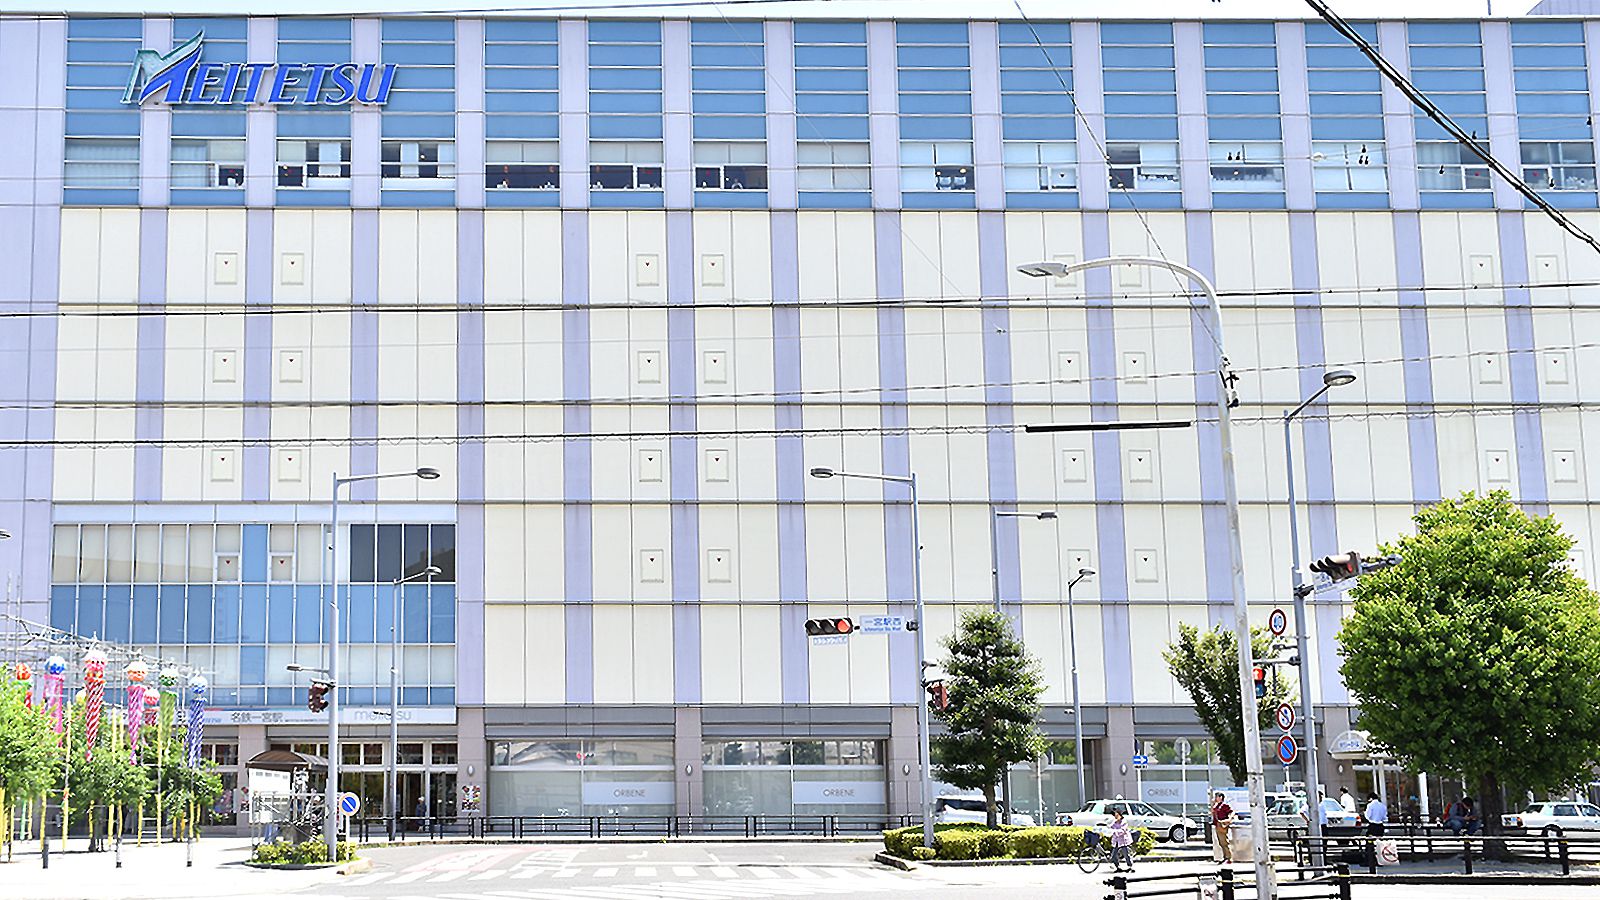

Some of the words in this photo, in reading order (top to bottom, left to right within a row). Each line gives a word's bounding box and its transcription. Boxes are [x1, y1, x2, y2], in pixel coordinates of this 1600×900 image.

[120, 29, 398, 106] MEITETSU
[864, 617, 902, 626] 一宮駅西
[231, 712, 284, 723] 名鉄一宮駅
[613, 789, 646, 798] ORBENE
[822, 789, 855, 798] ORBENE
[1147, 787, 1180, 797] ORBENE
